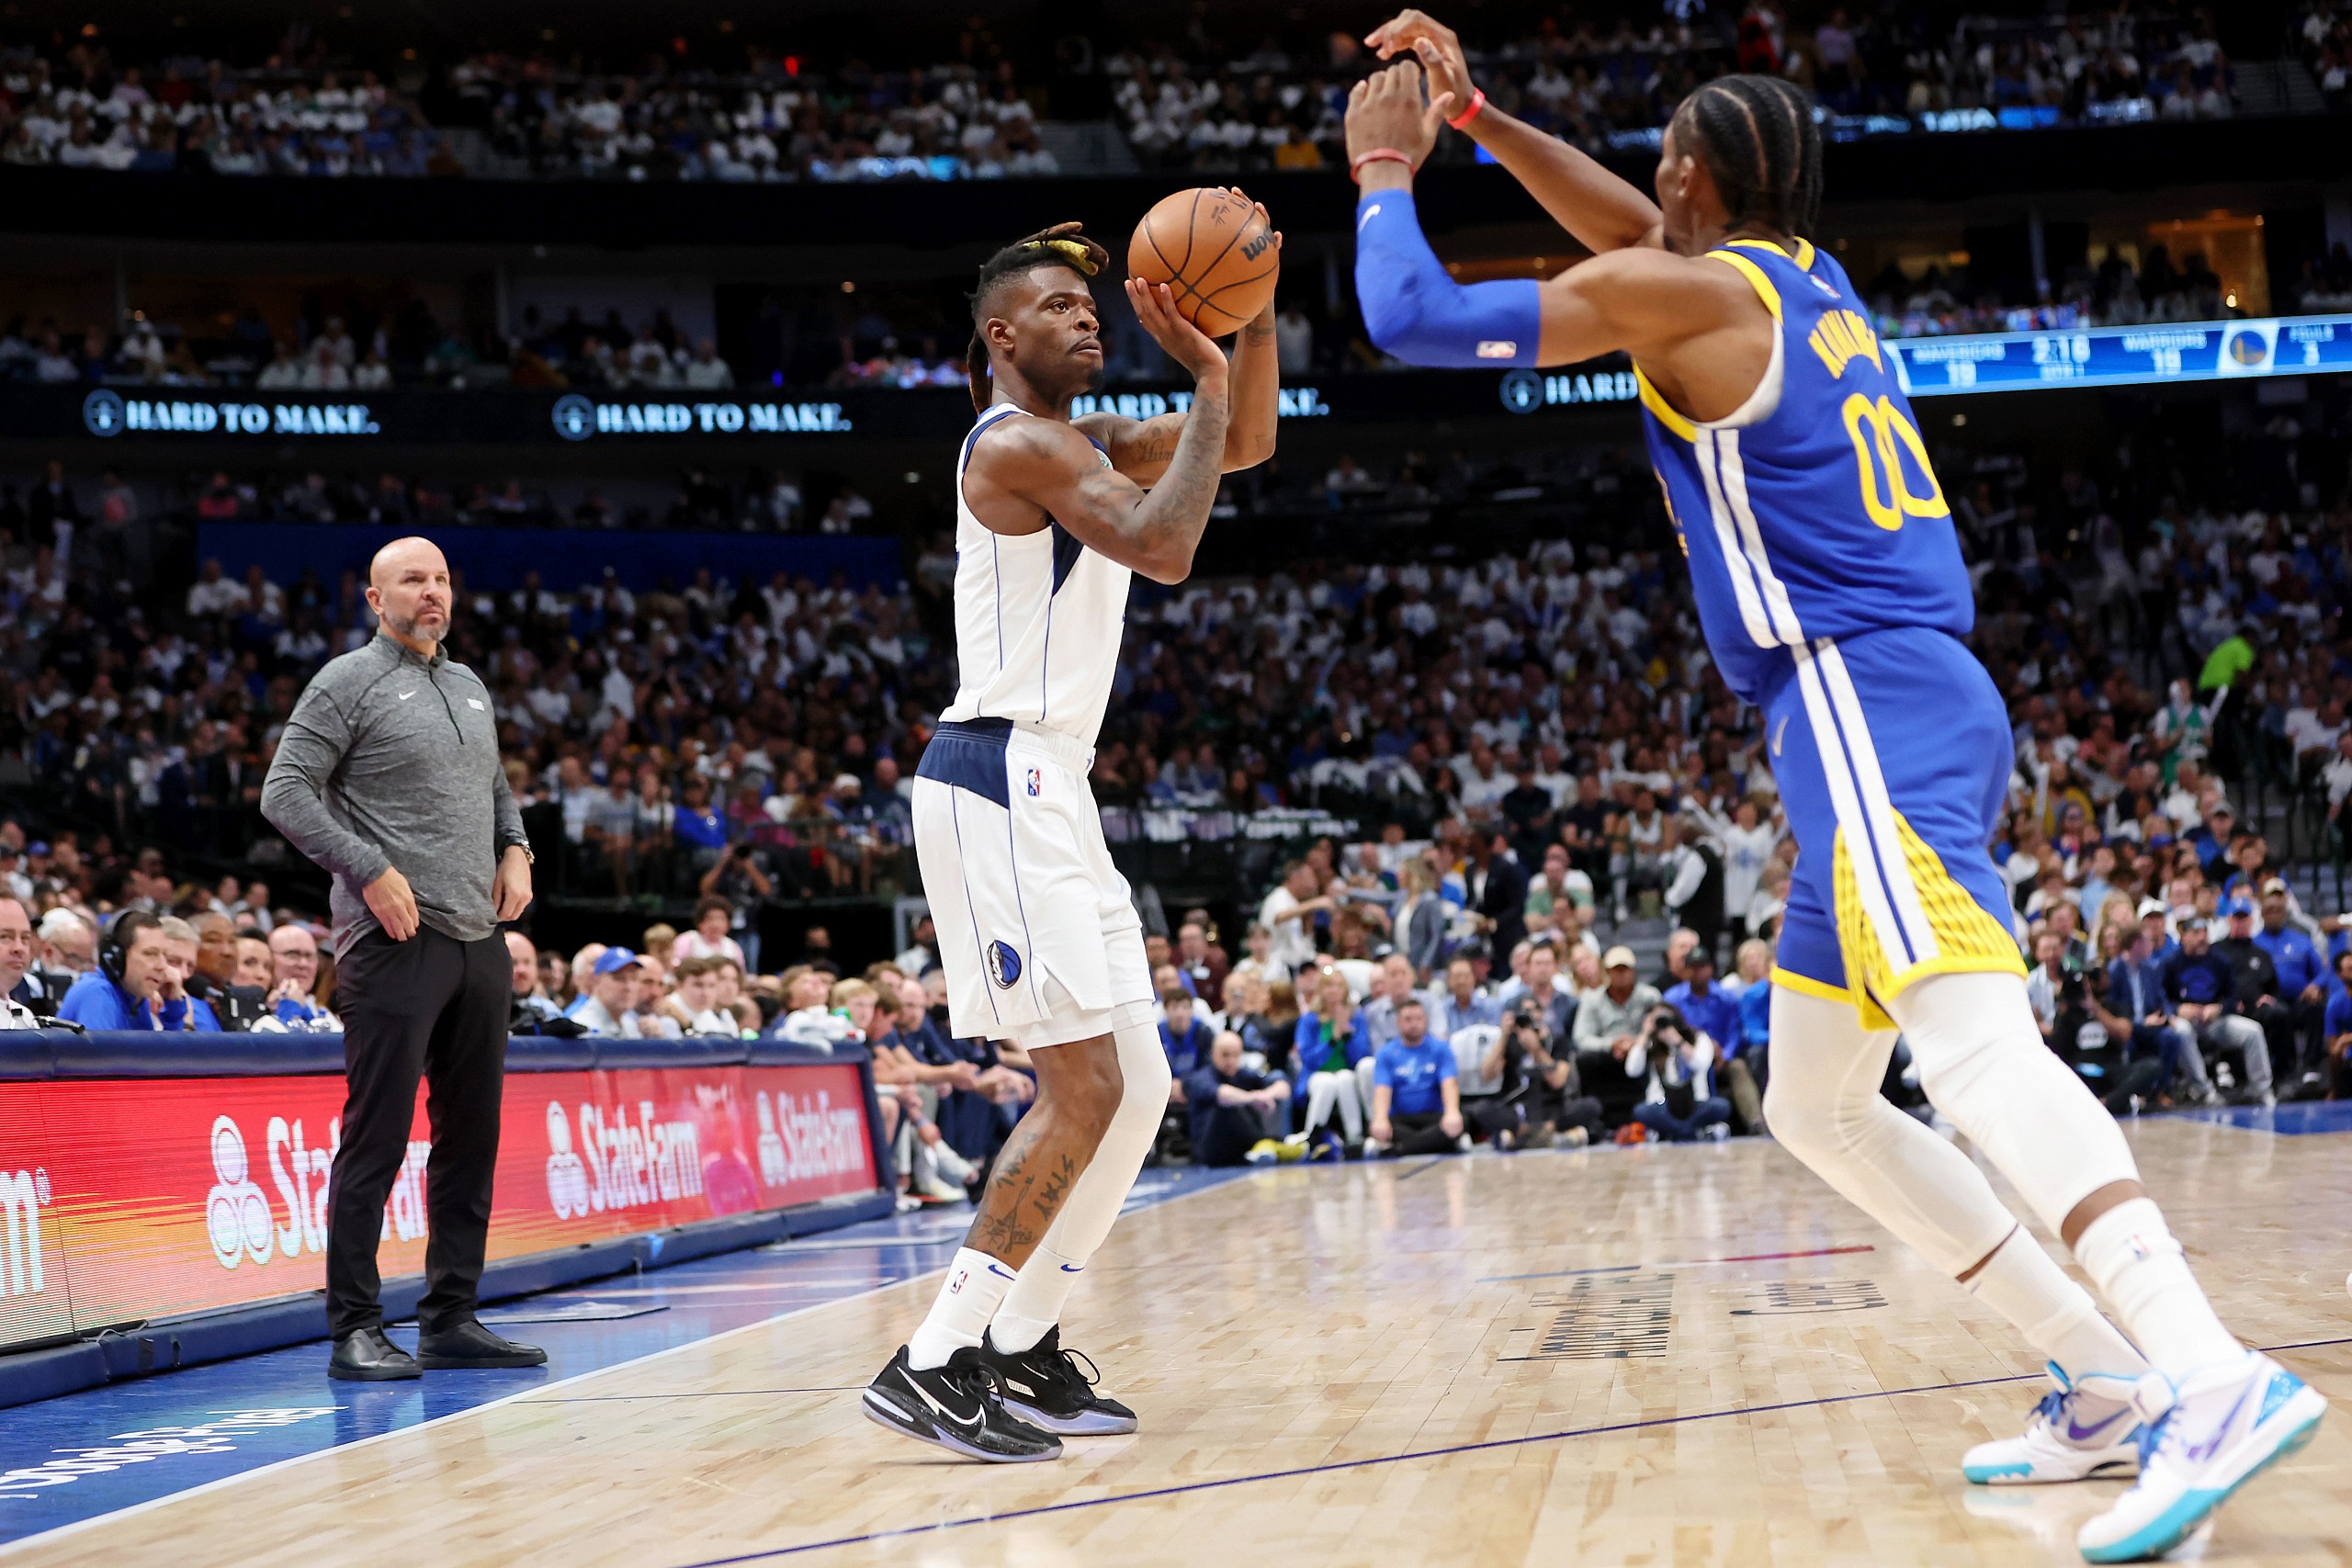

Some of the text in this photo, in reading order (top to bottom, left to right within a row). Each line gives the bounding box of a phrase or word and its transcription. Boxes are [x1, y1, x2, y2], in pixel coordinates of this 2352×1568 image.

[1544, 371, 1638, 405] HARD
[126, 400, 380, 434] HARD TO MAKE.
[597, 402, 853, 434] HARD TO MAKE.
[1842, 393, 1951, 531] 00
[1728, 1279, 1890, 1315] Center
